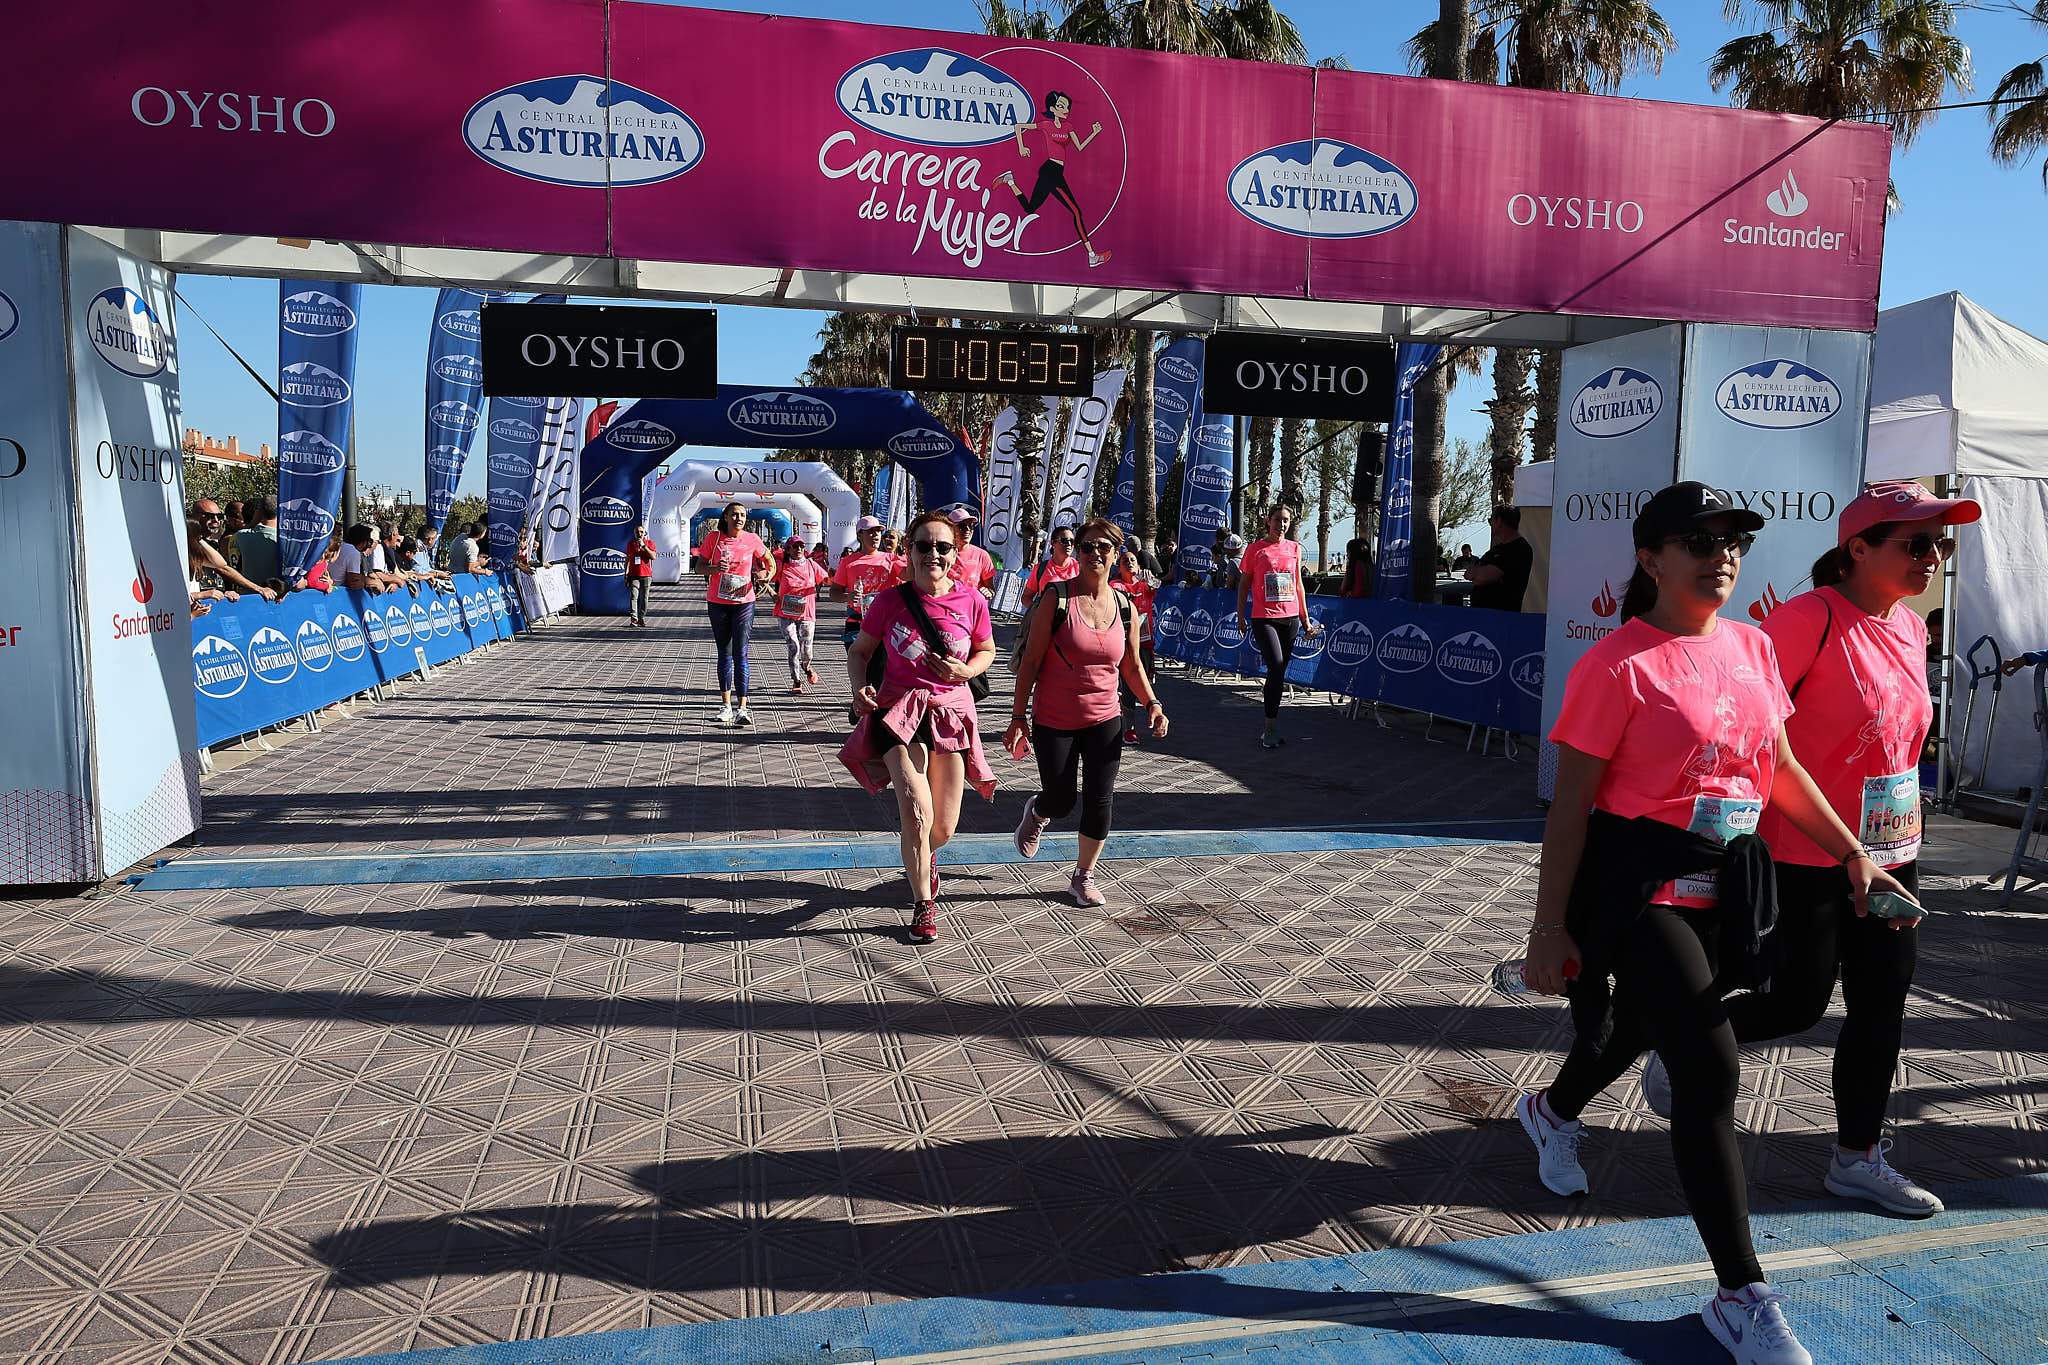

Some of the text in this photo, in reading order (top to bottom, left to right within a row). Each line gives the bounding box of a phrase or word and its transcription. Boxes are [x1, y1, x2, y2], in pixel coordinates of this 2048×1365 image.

[883, 78, 1014, 98] CENTRAL LECHERA
[131, 87, 336, 138] OYSHO
[852, 77, 1018, 126] ASTURIANA
[520, 110, 595, 125] CENTRAL
[482, 111, 686, 163] ASTURIANA
[818, 130, 983, 192] Carrera
[1273, 170, 1398, 188] CENTRAL LECHERA
[1242, 170, 1403, 216] ASTURIANA
[1508, 193, 1644, 233] OYSHO
[858, 187, 1040, 268] de la Mujer
[1724, 218, 1844, 251] Santander
[284, 304, 347, 328] ASTURIANA
[443, 317, 481, 334] ASTURI
[94, 309, 164, 362] ASTURIANA
[522, 333, 686, 370] OYSHO
[906, 336, 1079, 385] 01:06:32
[282, 377, 343, 400] STURIANA
[1236, 359, 1369, 396] OYSHO
[1744, 382, 1830, 393] CENTRAL LECHERA
[1154, 394, 1185, 411] STURIANA
[1589, 386, 1653, 402] CENTRAL LECHERA
[1724, 383, 1832, 413] ASTURIANA
[736, 404, 829, 427] ASTURIANA
[1575, 396, 1655, 425] ASTURIANA
[493, 424, 536, 441] ASTURIANA
[608, 430, 670, 446] ASTURIANA
[893, 439, 950, 452] ASTURIANA
[97, 440, 174, 485] OYSHO
[1054, 396, 1108, 530] OYSHO
[715, 466, 798, 486] OYSHO
[988, 430, 1021, 546] OYSHO
[490, 496, 524, 509] STURIANA
[583, 507, 631, 520] ASTURIANA
[583, 557, 625, 570] ASTURIAN
[112, 607, 175, 640] Santander
[1566, 619, 1614, 642] Santan
[299, 641, 331, 662] ASTURIANA
[1329, 635, 1369, 656] ASTURIANA
[1379, 640, 1427, 664] ASTURIANA
[252, 650, 296, 673] ASTURIANA
[1439, 647, 1493, 676] ASTURIANA
[194, 661, 246, 687] ASTURIANA
